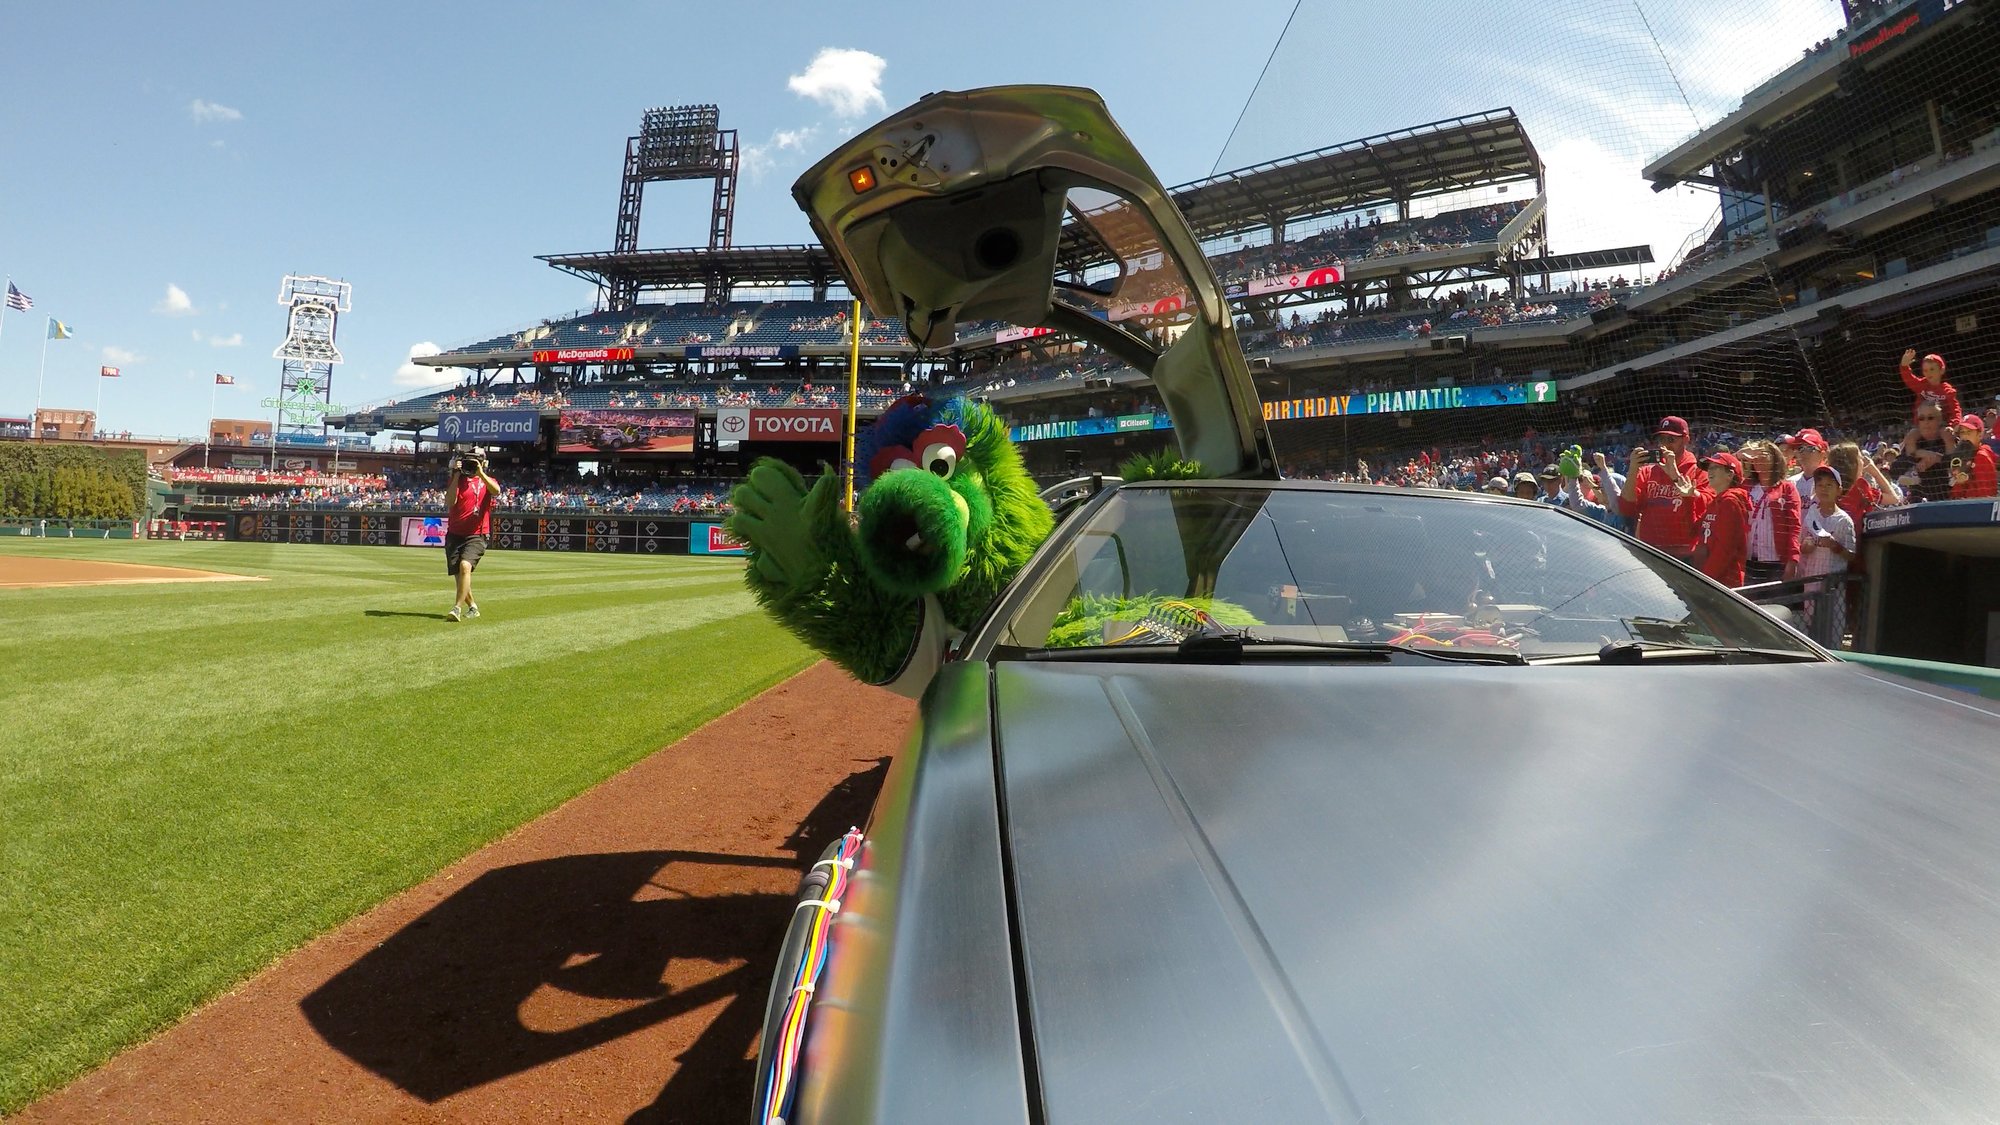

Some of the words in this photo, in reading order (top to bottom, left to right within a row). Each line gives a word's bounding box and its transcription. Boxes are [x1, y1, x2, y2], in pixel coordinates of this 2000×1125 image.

[558, 350, 608, 359] McDonald's
[742, 347, 780, 356] BAKERY
[1263, 395, 1351, 420] BIRTHDAY
[1366, 387, 1463, 413] PHANATIC
[290, 413, 316, 424] Park
[466, 418, 532, 433] LifeBrand
[755, 417, 834, 432] TOYOTA
[1126, 419, 1150, 427] Citizens
[1020, 421, 1077, 441] PHANATIC
[1898, 512, 1911, 526] Park
